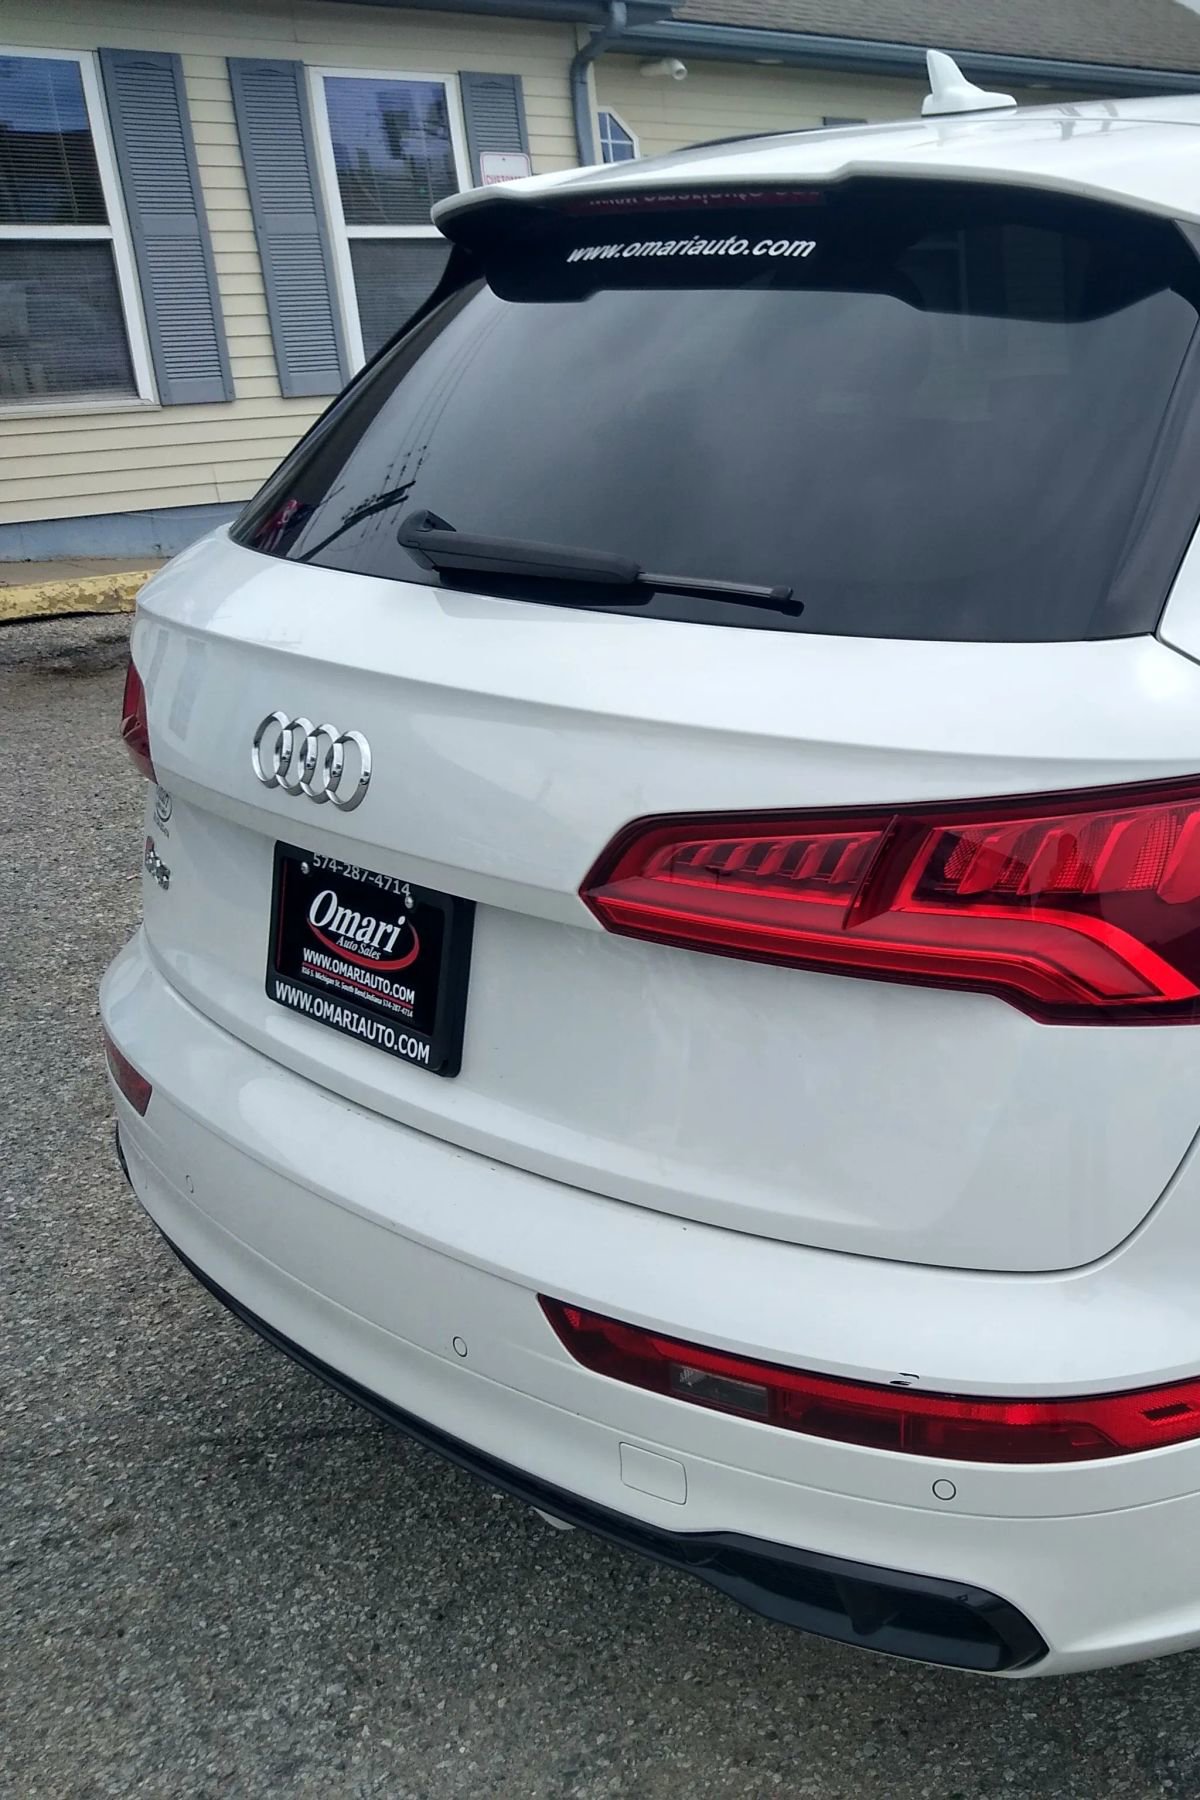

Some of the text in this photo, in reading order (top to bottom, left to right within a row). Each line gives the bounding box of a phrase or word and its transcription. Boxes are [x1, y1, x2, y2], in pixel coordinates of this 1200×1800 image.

[566, 235, 816, 263] www.omariauto.com
[313, 852, 411, 896] 574-287-4714
[309, 889, 406, 953] Omari
[336, 936, 381, 960] Auto Sales
[303, 947, 415, 1005] WWW.OMARIAUTO.COM
[275, 980, 430, 1065] WWW.OMARIAUTO.COM
